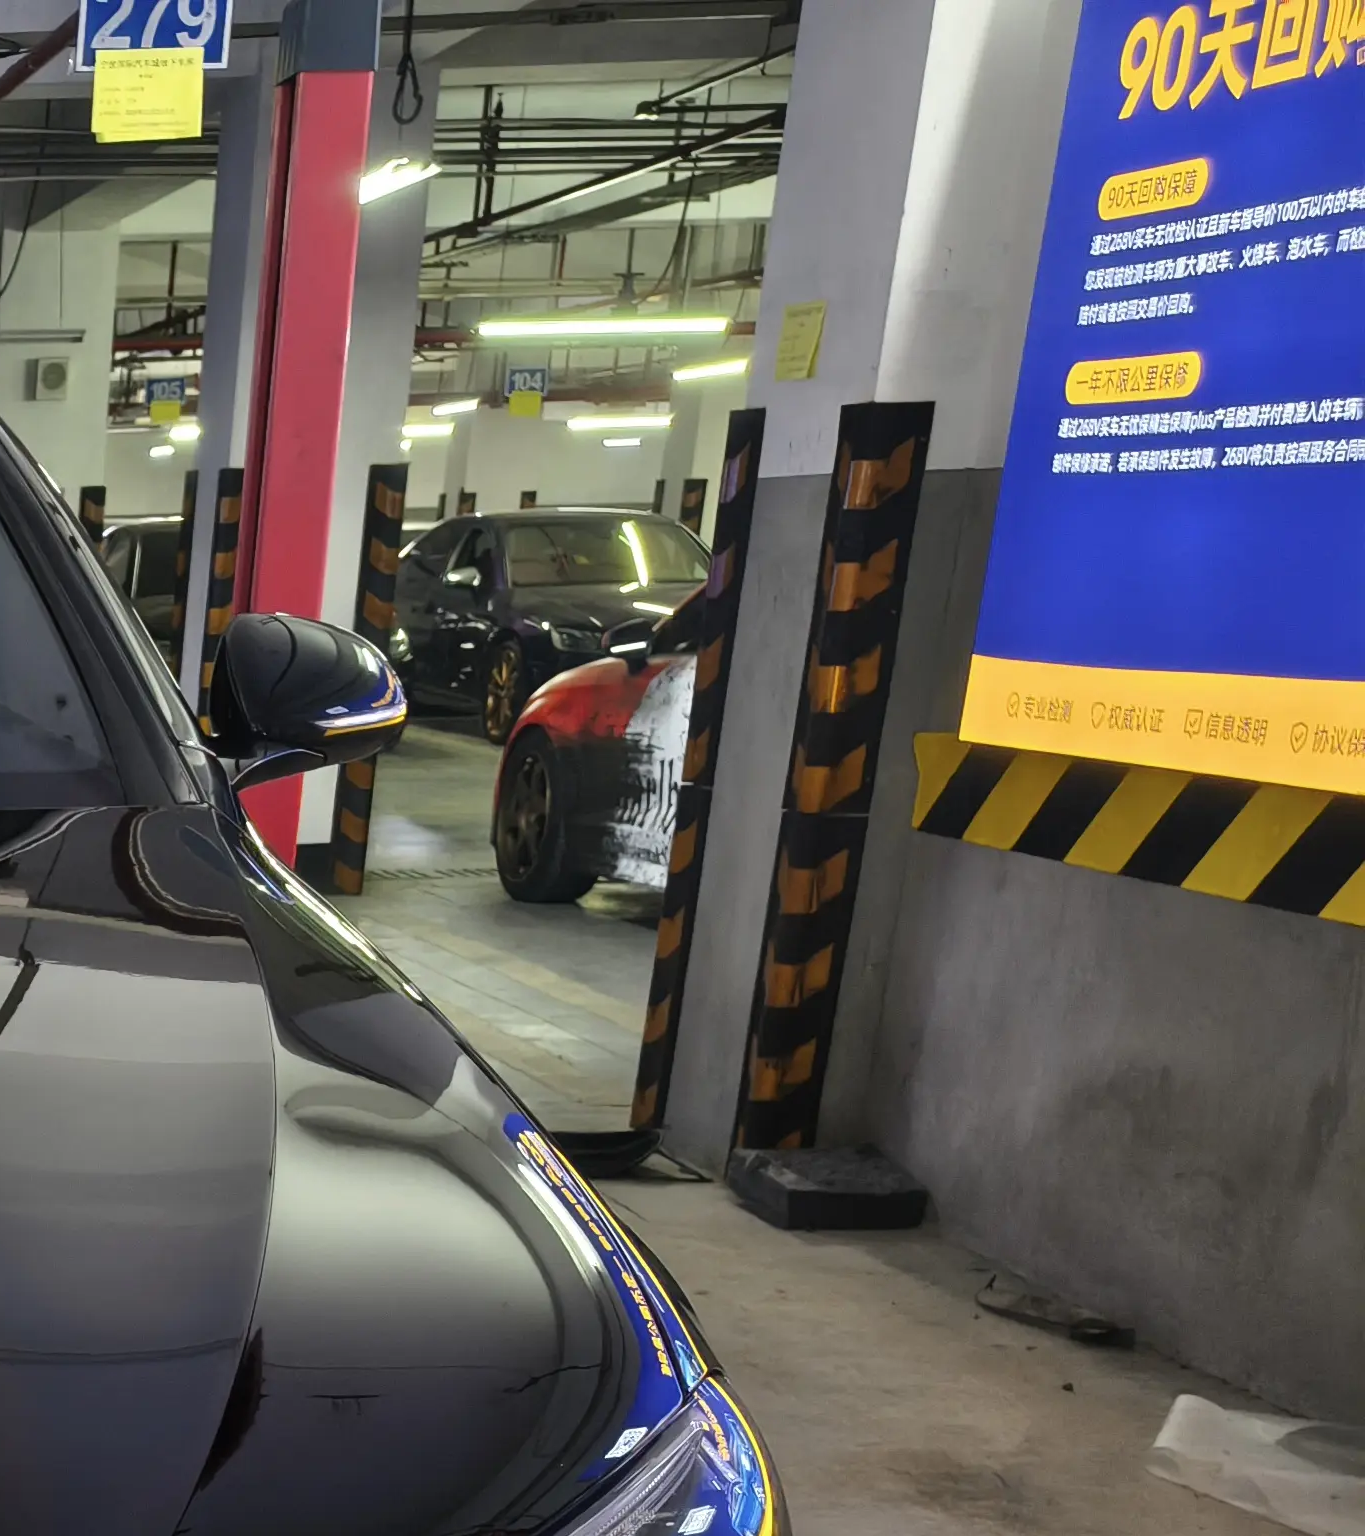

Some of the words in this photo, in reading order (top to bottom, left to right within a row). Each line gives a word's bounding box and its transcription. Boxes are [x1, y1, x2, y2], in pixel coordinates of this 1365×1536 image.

[91, 0, 217, 49] 279
[1108, 168, 1199, 210] 90天回购保障
[511, 372, 543, 390] 104
[1076, 361, 1190, 396] 一年不限公里保修
[1023, 695, 1074, 724] 专业检测
[1108, 704, 1166, 734] 权威认证
[1205, 713, 1269, 748] 信息透明
